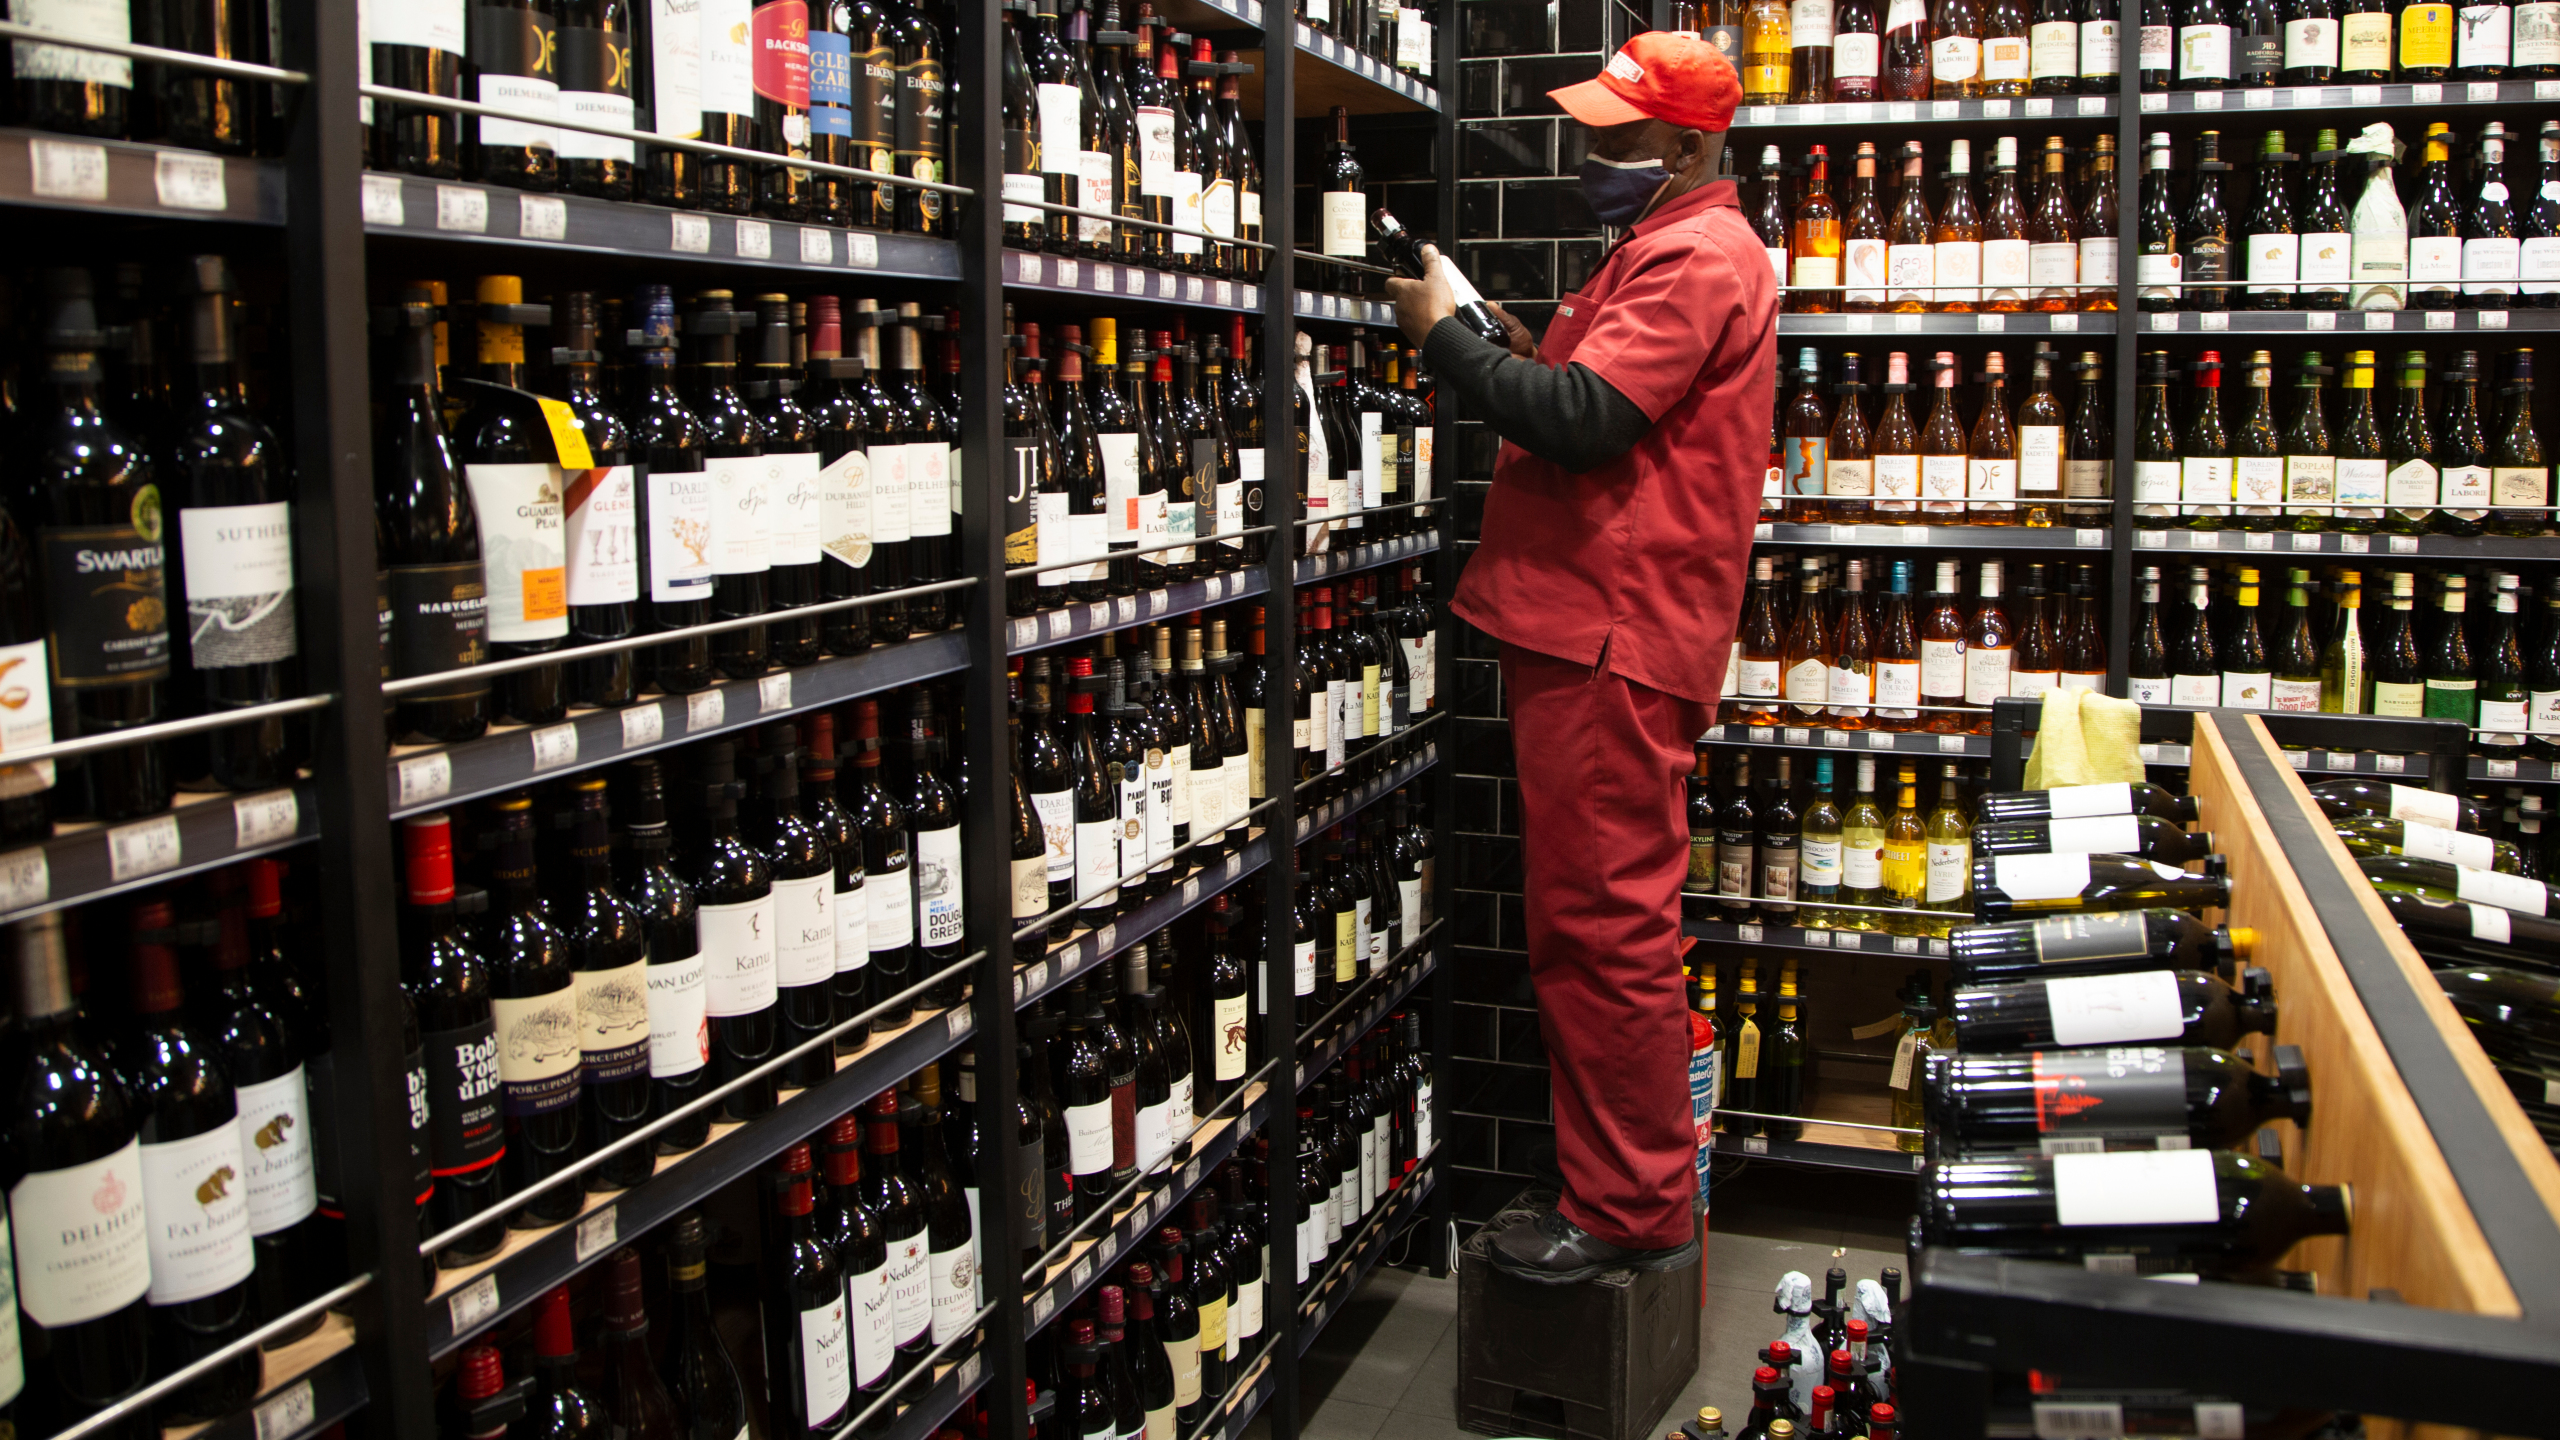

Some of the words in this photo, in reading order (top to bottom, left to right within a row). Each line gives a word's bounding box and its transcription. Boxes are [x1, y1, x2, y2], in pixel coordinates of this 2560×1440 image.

[1996, 46, 2018, 55] FLEUR
[1936, 55, 1970, 64] LABORIE
[2192, 246, 2227, 254] EIKENDAL
[1880, 457, 1911, 466] DARLING
[1929, 458, 1960, 467] DARLING
[2245, 460, 2279, 468] DARLING
[2292, 461, 2334, 470] BOPLAAS
[2451, 488, 2488, 497] LABORIE
[845, 500, 867, 510] HILLS
[535, 518, 558, 530] PEAK
[456, 618, 485, 632] MERLOT
[1894, 677, 1911, 685] BON
[1880, 683, 1915, 692] COURAGE
[2278, 702, 2300, 712] GOOD
[2301, 700, 2318, 710] HOPE
[1690, 834, 1715, 843] SKYLINE
[1767, 834, 1791, 842] DROSTDY
[886, 854, 907, 867] KWV
[1885, 851, 1910, 862] STREET
[1931, 857, 1961, 869] Nederburg
[1934, 871, 1956, 880] LYRIC
[930, 900, 943, 908] 2019
[930, 903, 956, 914] MERLOT
[802, 923, 833, 944] Kanu
[735, 950, 771, 972] Kanu
[806, 951, 830, 964] MERLOT
[647, 976, 678, 993] VAN
[741, 980, 768, 993] MERLOT
[1223, 1005, 1237, 1014] THE
[598, 1063, 632, 1080] MERLOT
[508, 1075, 573, 1097] PORCUPINE
[536, 1093, 567, 1110] MERLOT
[464, 1122, 493, 1139] MERLOT
[166, 1221, 201, 1242] FAT
[896, 1278, 927, 1300] DUET
